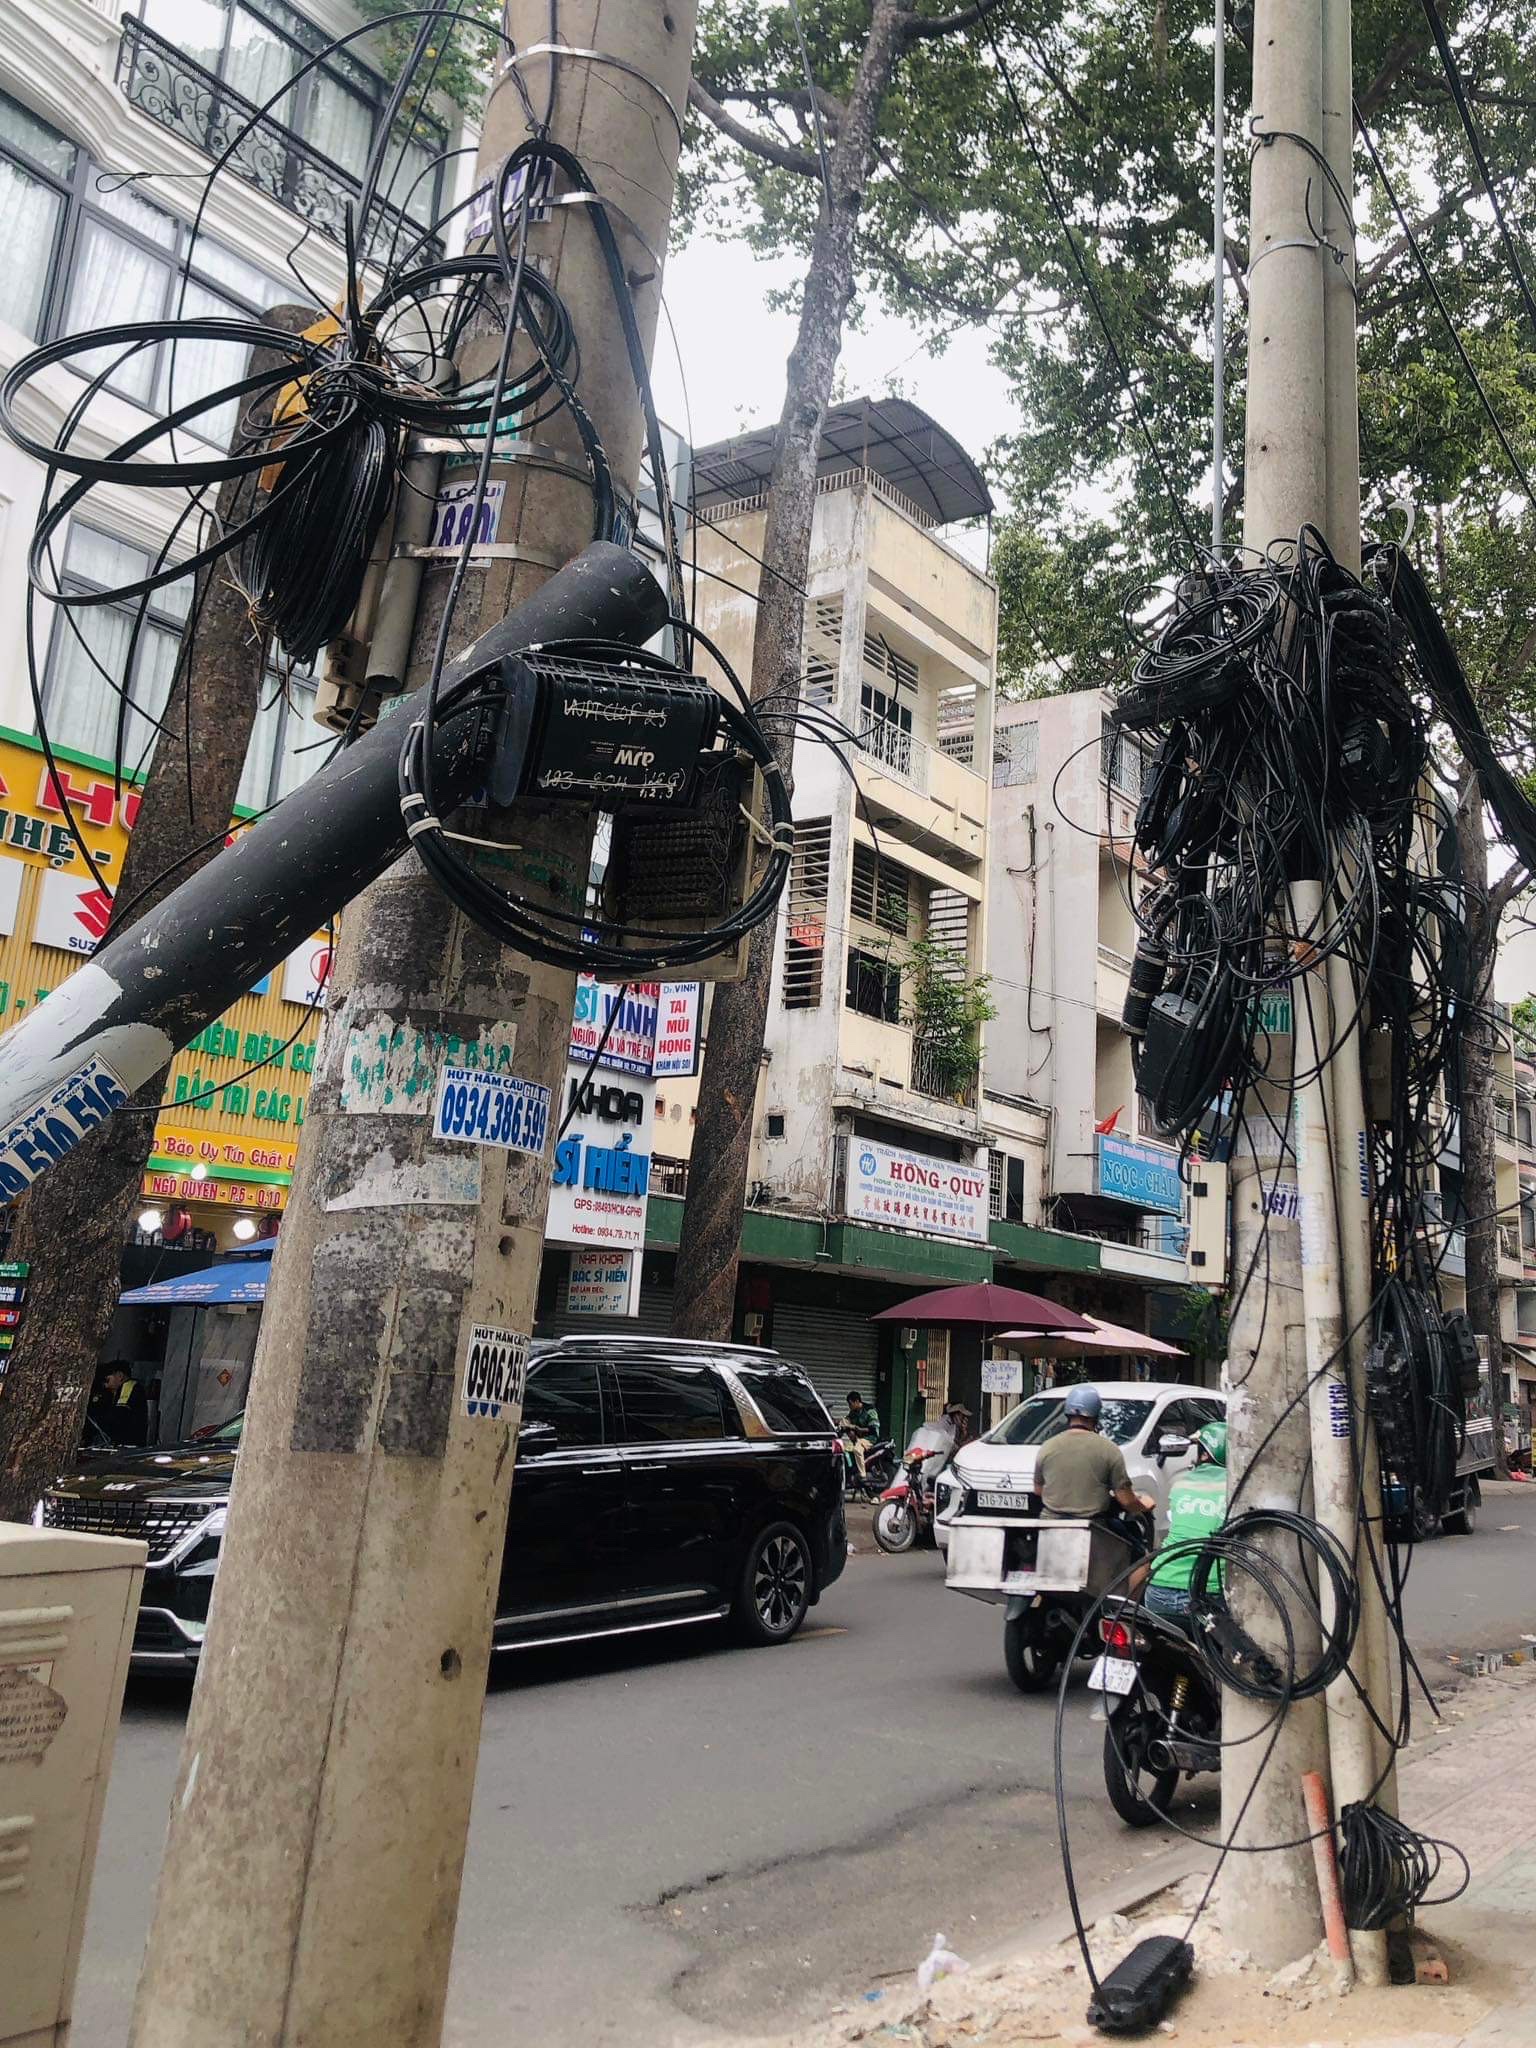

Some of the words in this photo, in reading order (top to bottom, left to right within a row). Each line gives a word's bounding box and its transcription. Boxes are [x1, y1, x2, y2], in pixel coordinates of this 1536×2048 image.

[605, 994, 657, 1037] VINH
[670, 1000, 687, 1014] TAI
[666, 1017, 690, 1034] MŨI
[658, 1039, 692, 1058] HỌNG
[569, 1079, 644, 1125] KHOA
[441, 1084, 547, 1152] 0934.386.599
[200, 1142, 220, 1162] Uy
[552, 1134, 585, 1186] SĨ
[584, 1133, 650, 1196] HIỂN
[599, 1254, 624, 1265] KHOA
